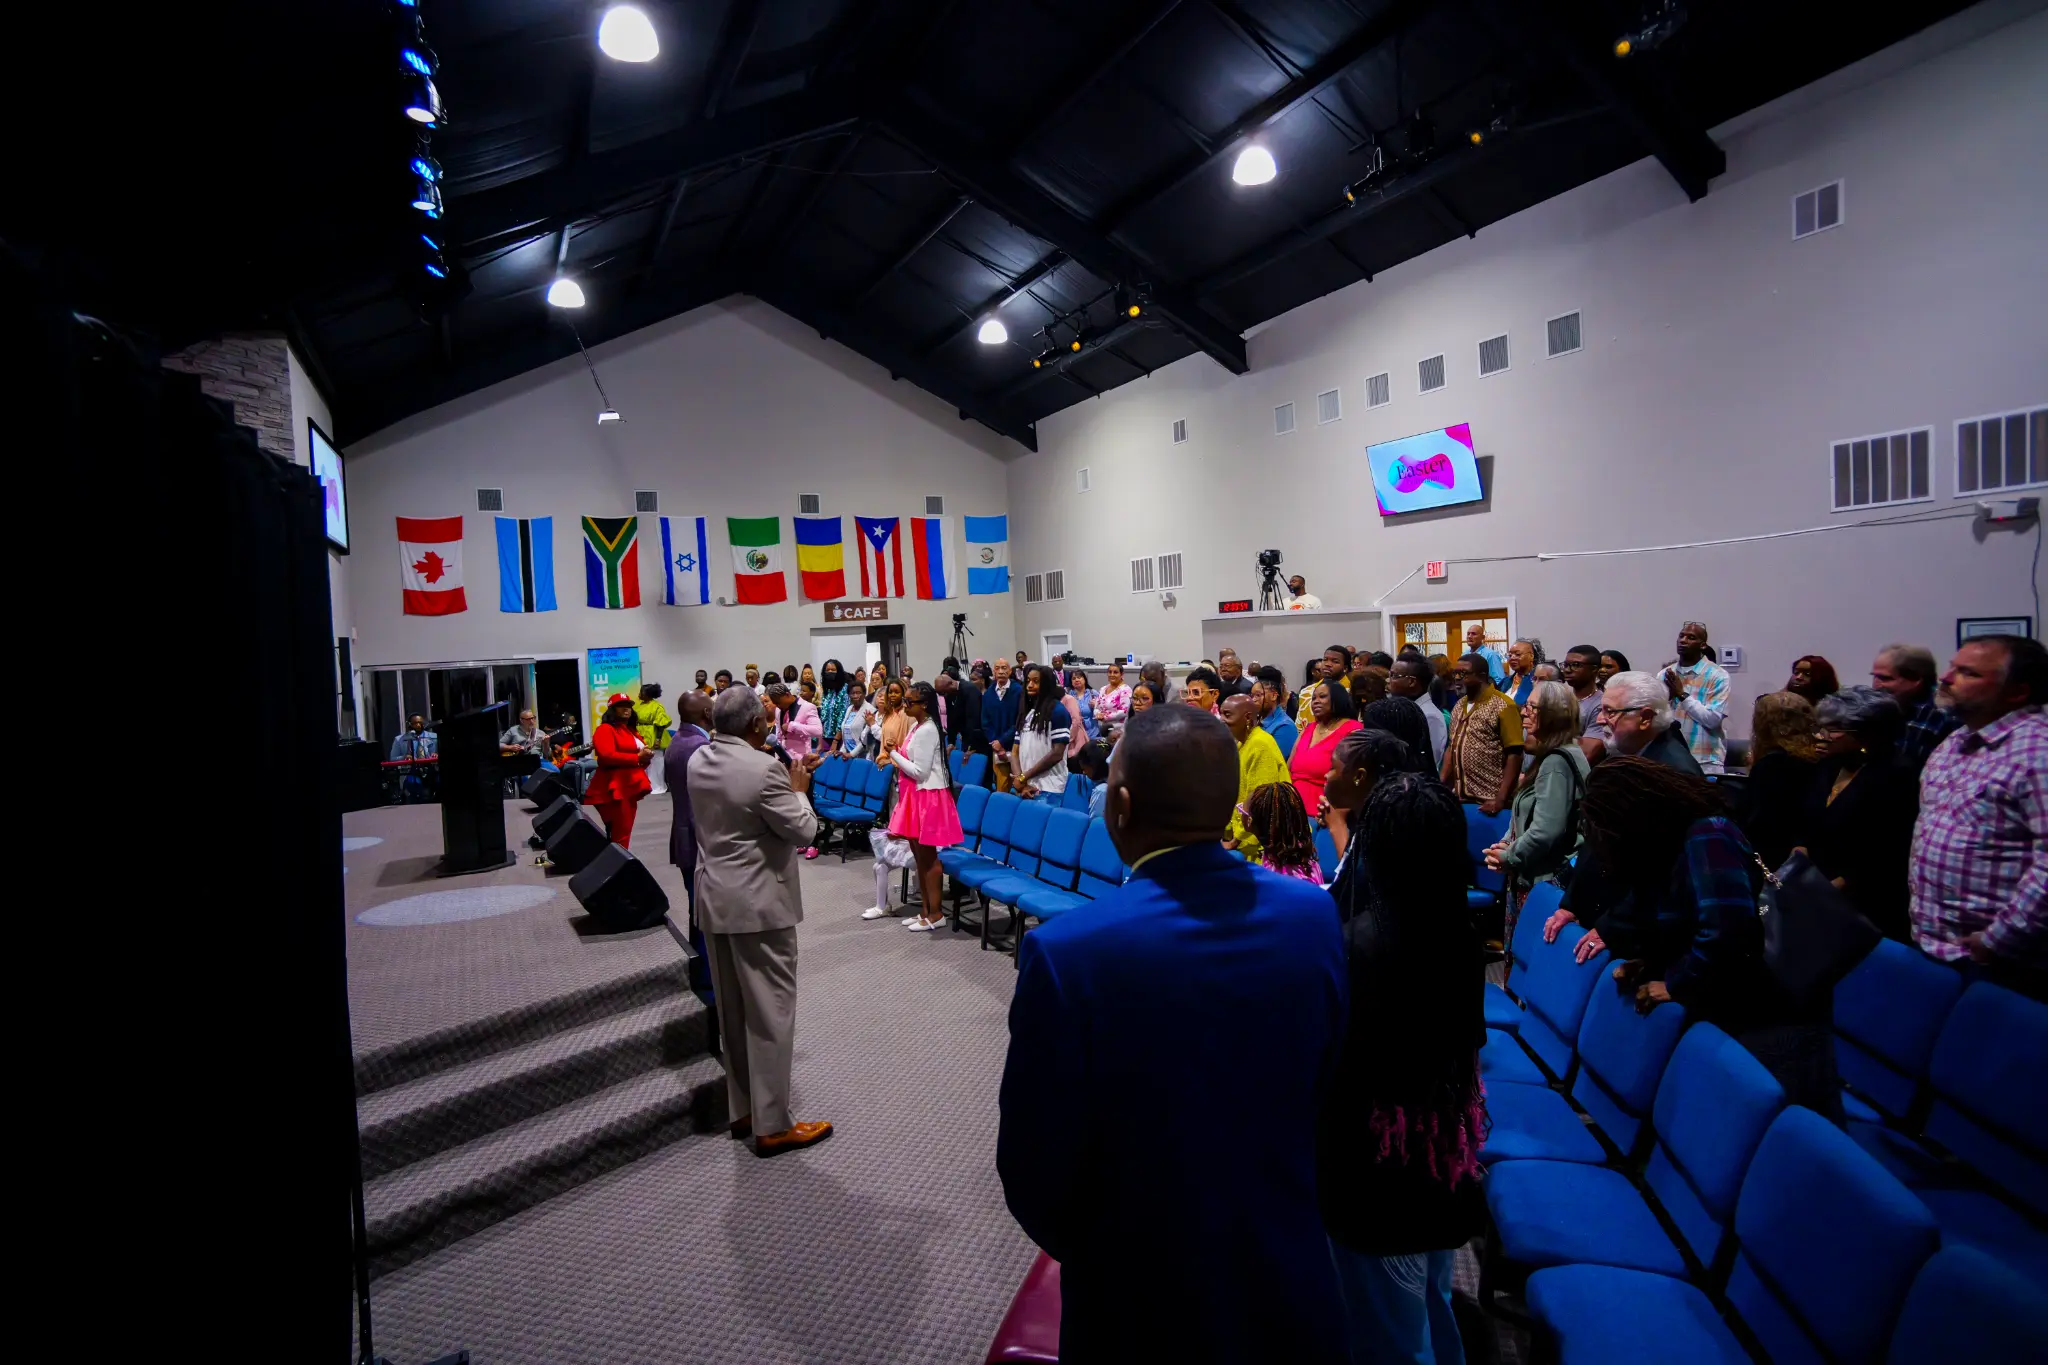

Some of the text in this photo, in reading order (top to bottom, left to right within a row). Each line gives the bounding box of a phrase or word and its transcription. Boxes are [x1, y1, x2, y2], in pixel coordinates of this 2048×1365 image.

[1396, 458, 1447, 480] Easter
[1427, 561, 1442, 577] EXIT
[844, 606, 881, 619] CAFE
